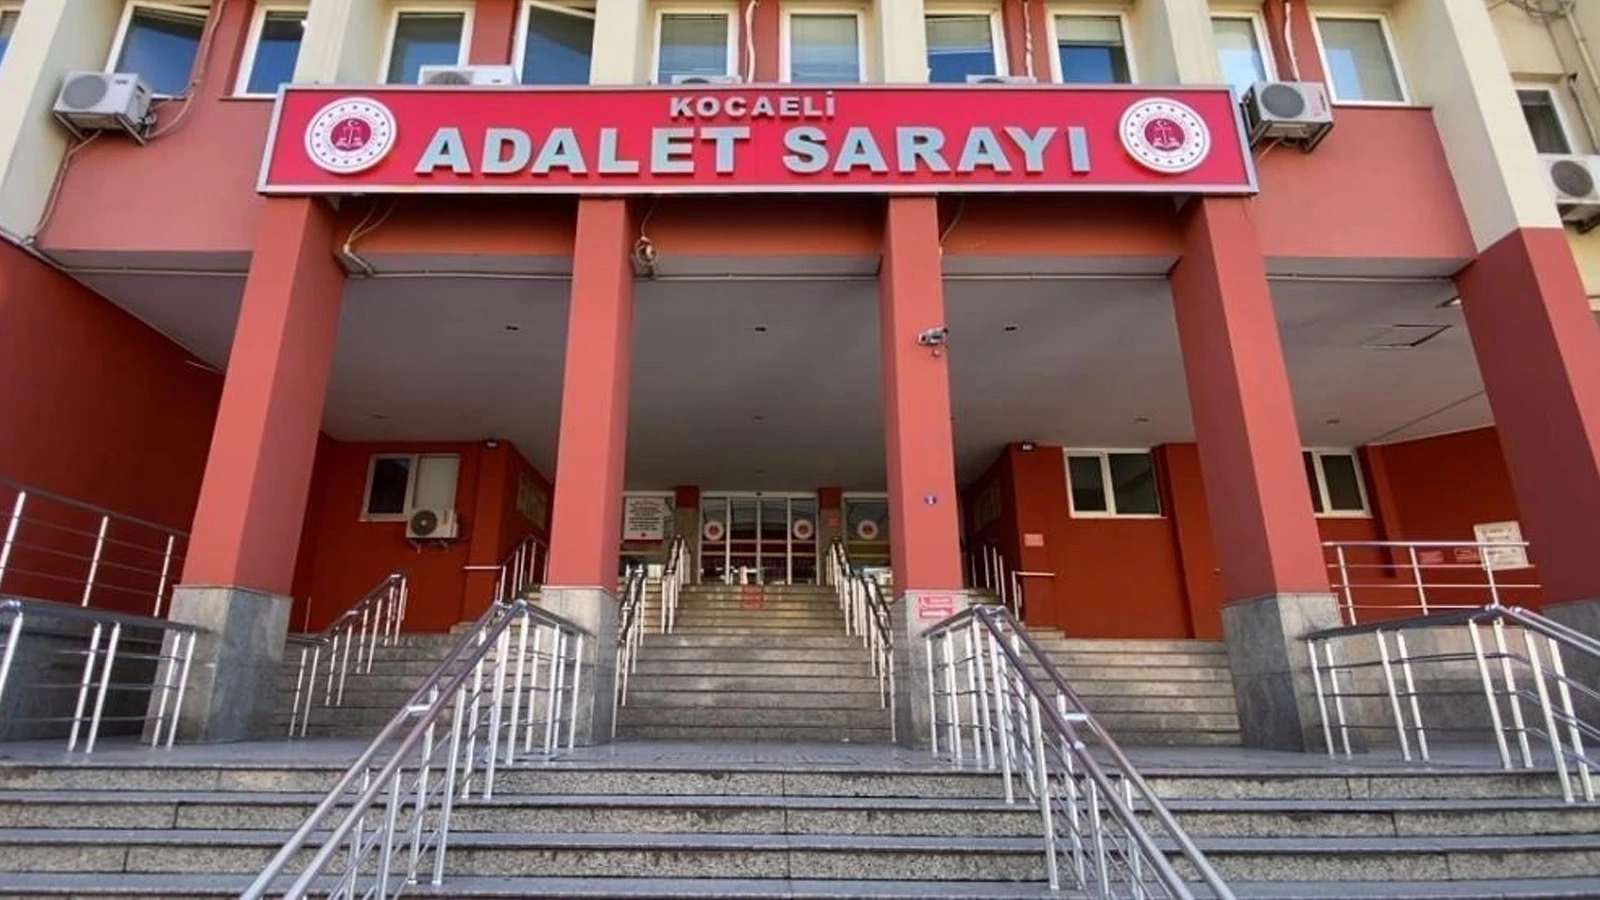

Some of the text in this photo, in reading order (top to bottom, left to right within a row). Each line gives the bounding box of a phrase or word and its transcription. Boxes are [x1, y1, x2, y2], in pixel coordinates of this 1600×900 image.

[669, 90, 836, 118] KOCAELİ
[414, 126, 751, 174] ADALET
[782, 126, 1092, 174] SARAYI
